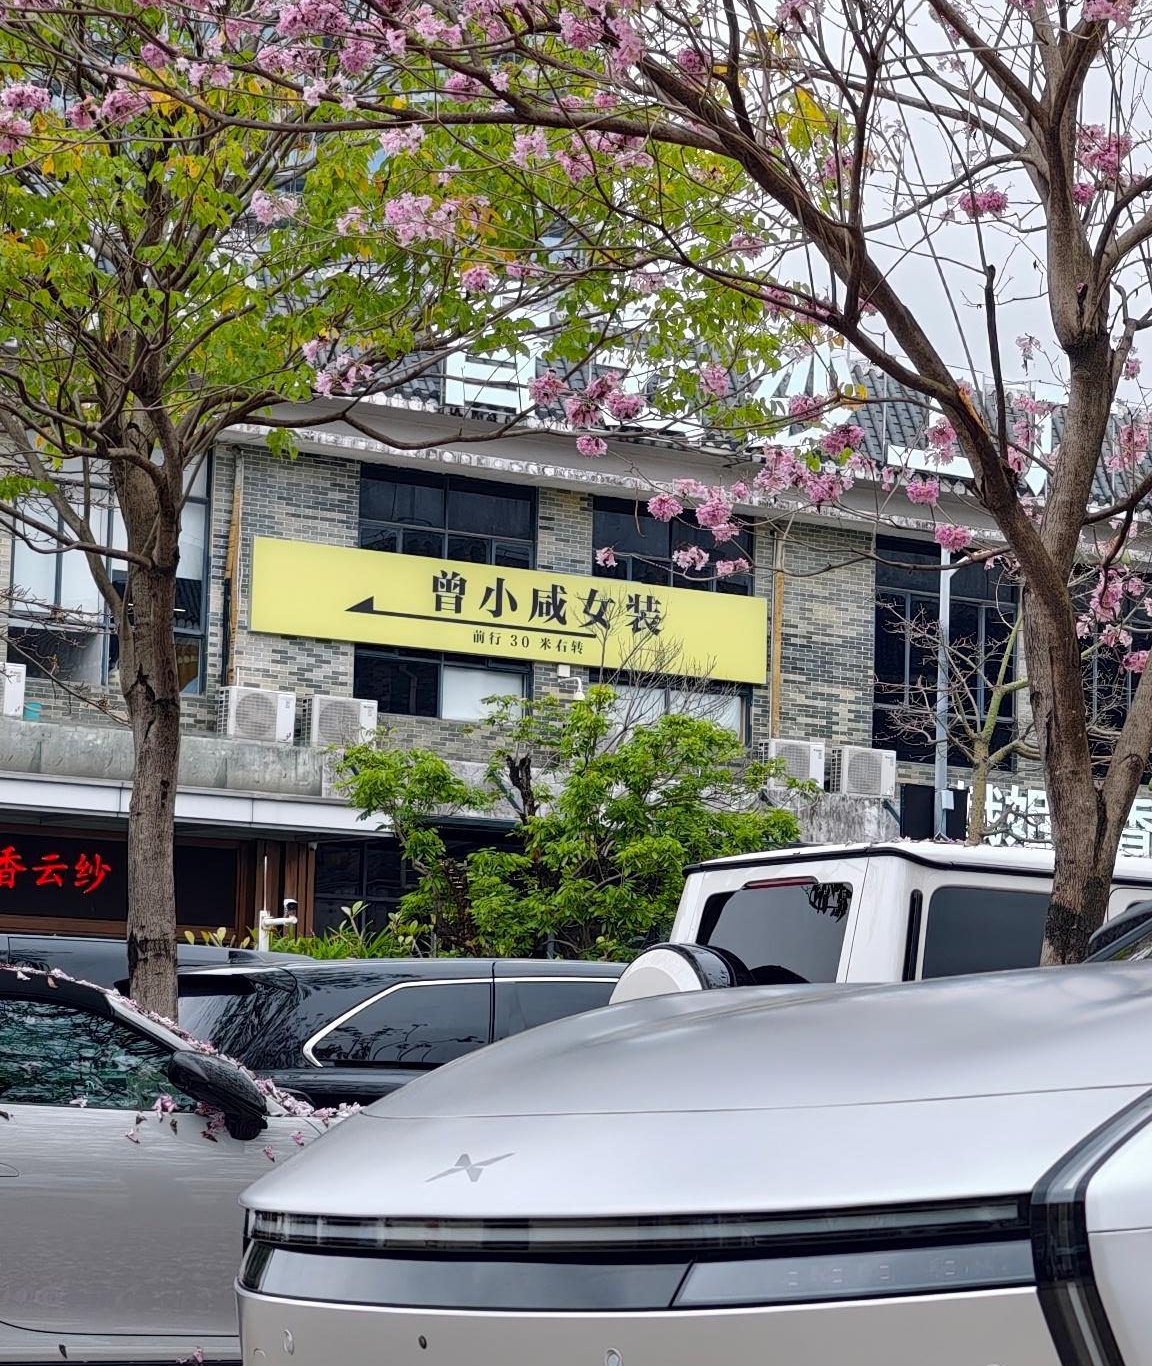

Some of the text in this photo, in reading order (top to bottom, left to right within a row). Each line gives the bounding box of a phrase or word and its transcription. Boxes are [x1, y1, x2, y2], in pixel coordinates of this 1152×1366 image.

[432, 569, 662, 635] 曾小咸女装
[473, 629, 585, 655] 前行 30 米右转
